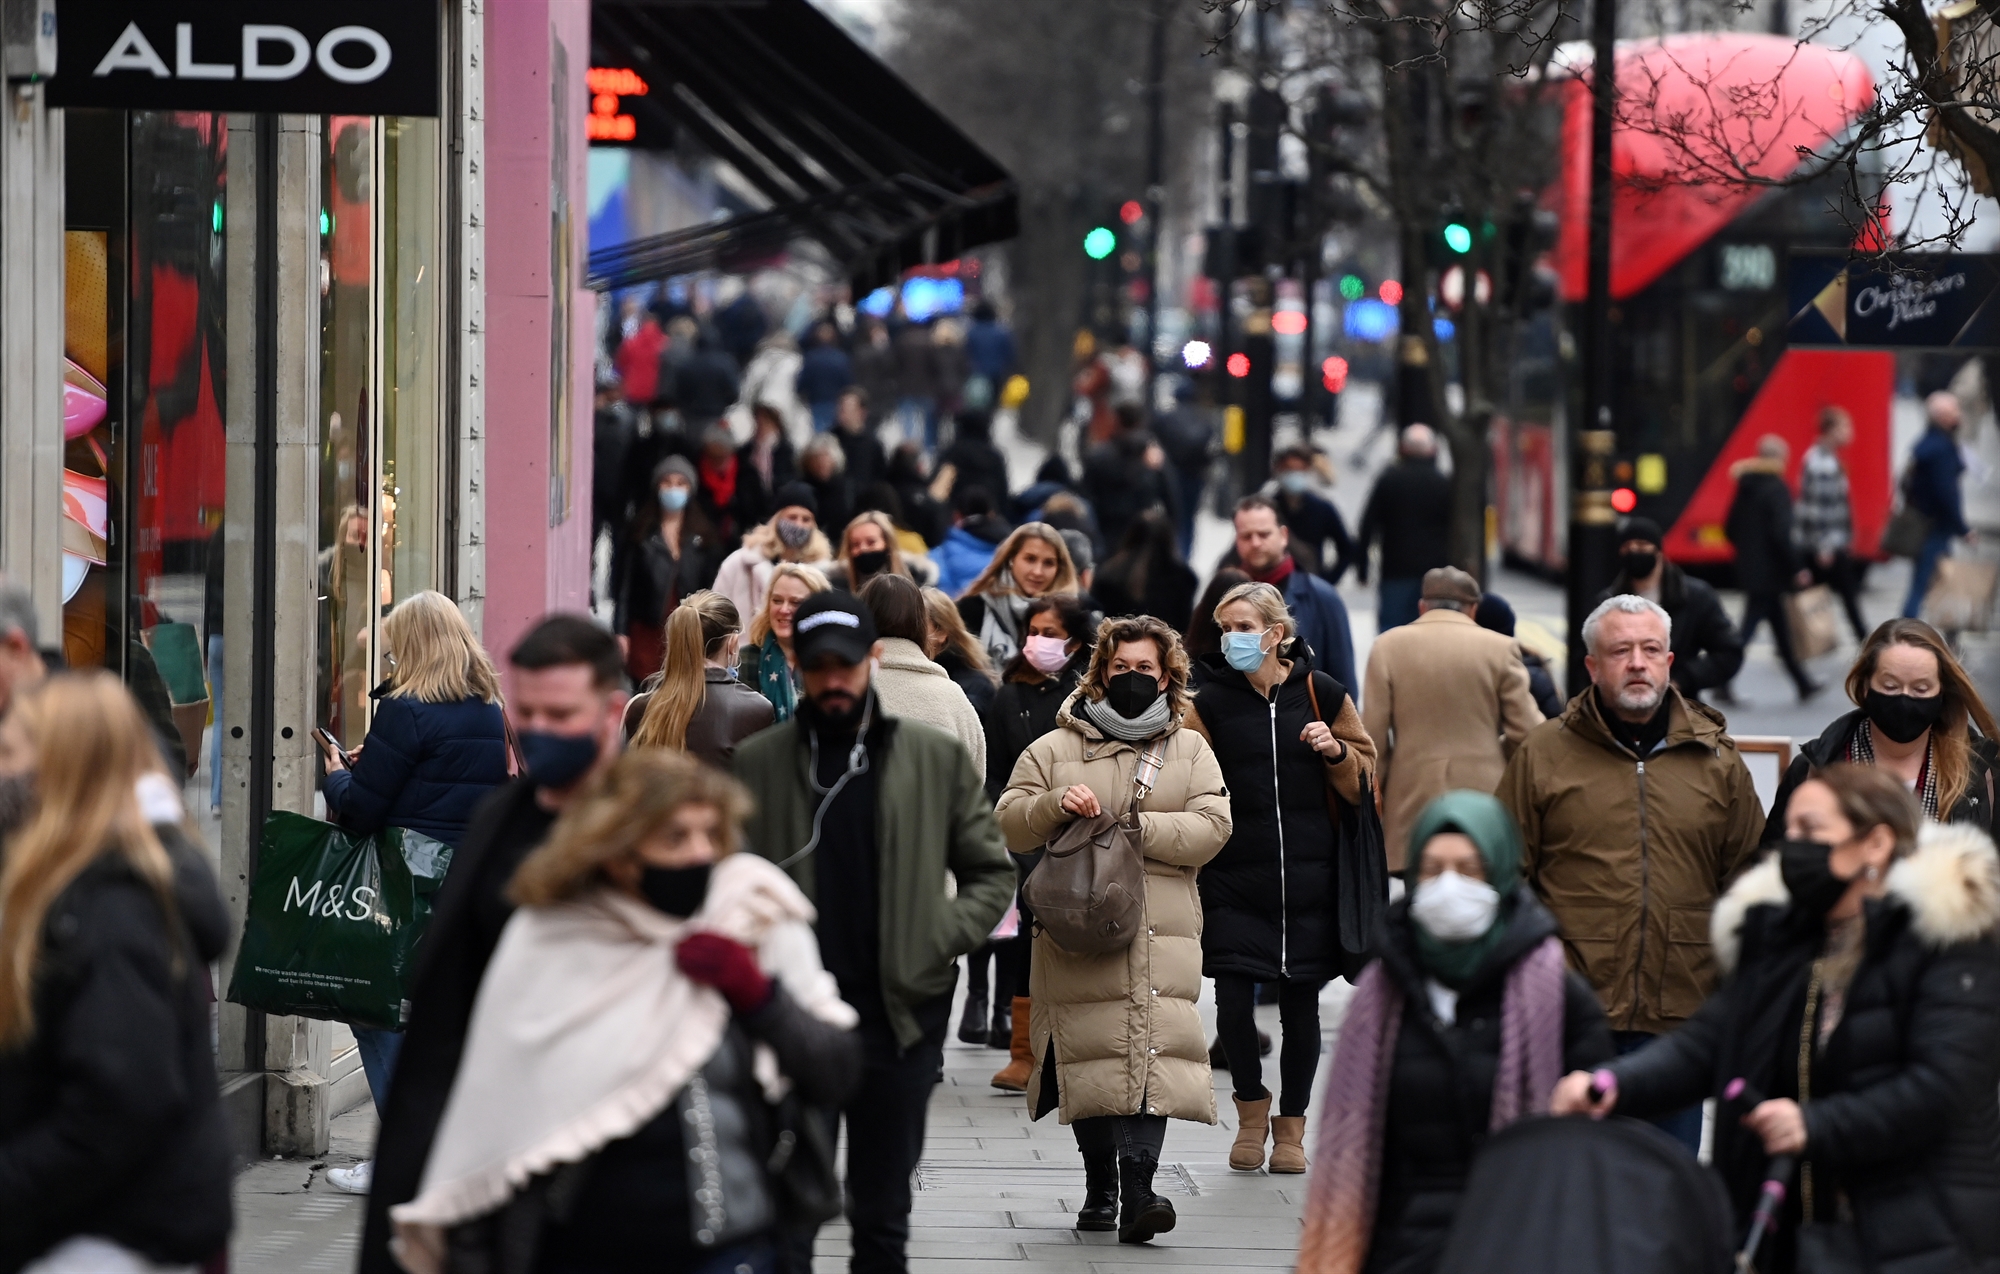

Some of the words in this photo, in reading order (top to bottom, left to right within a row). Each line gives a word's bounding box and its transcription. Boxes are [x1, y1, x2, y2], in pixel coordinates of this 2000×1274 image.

[91, 19, 393, 85] ALDO
[283, 875, 376, 921] M&S
[262, 967, 280, 976] recycle
